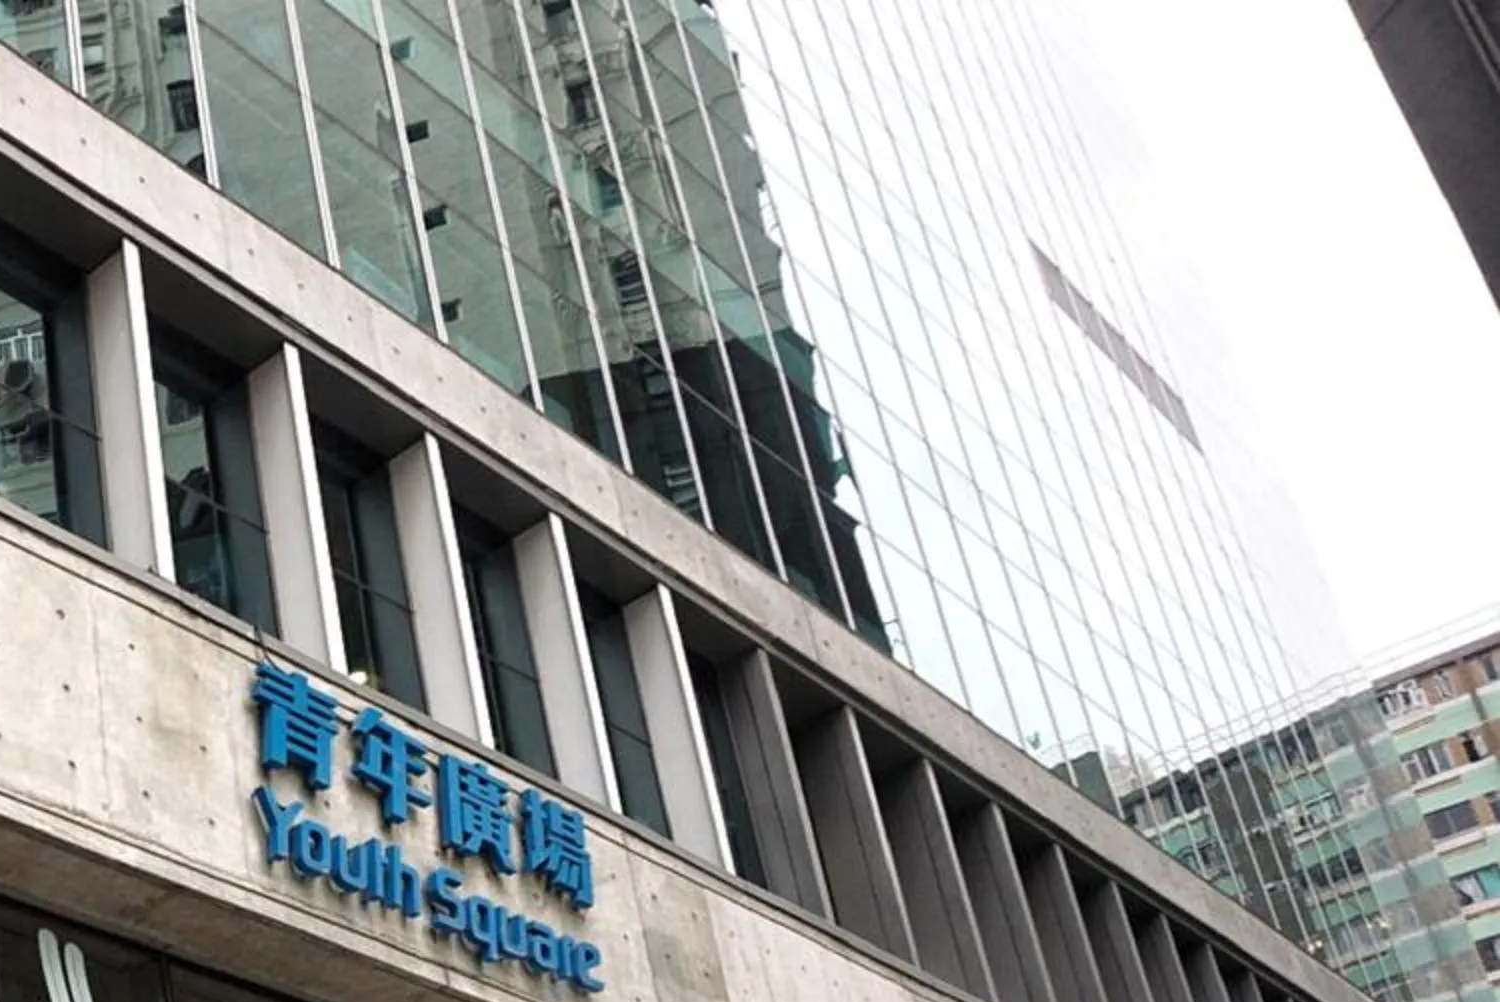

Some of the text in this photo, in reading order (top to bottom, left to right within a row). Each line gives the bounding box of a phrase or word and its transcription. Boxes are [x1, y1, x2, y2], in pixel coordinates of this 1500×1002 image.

[251, 784, 422, 917] Youth
[252, 662, 594, 909] 青年廣場
